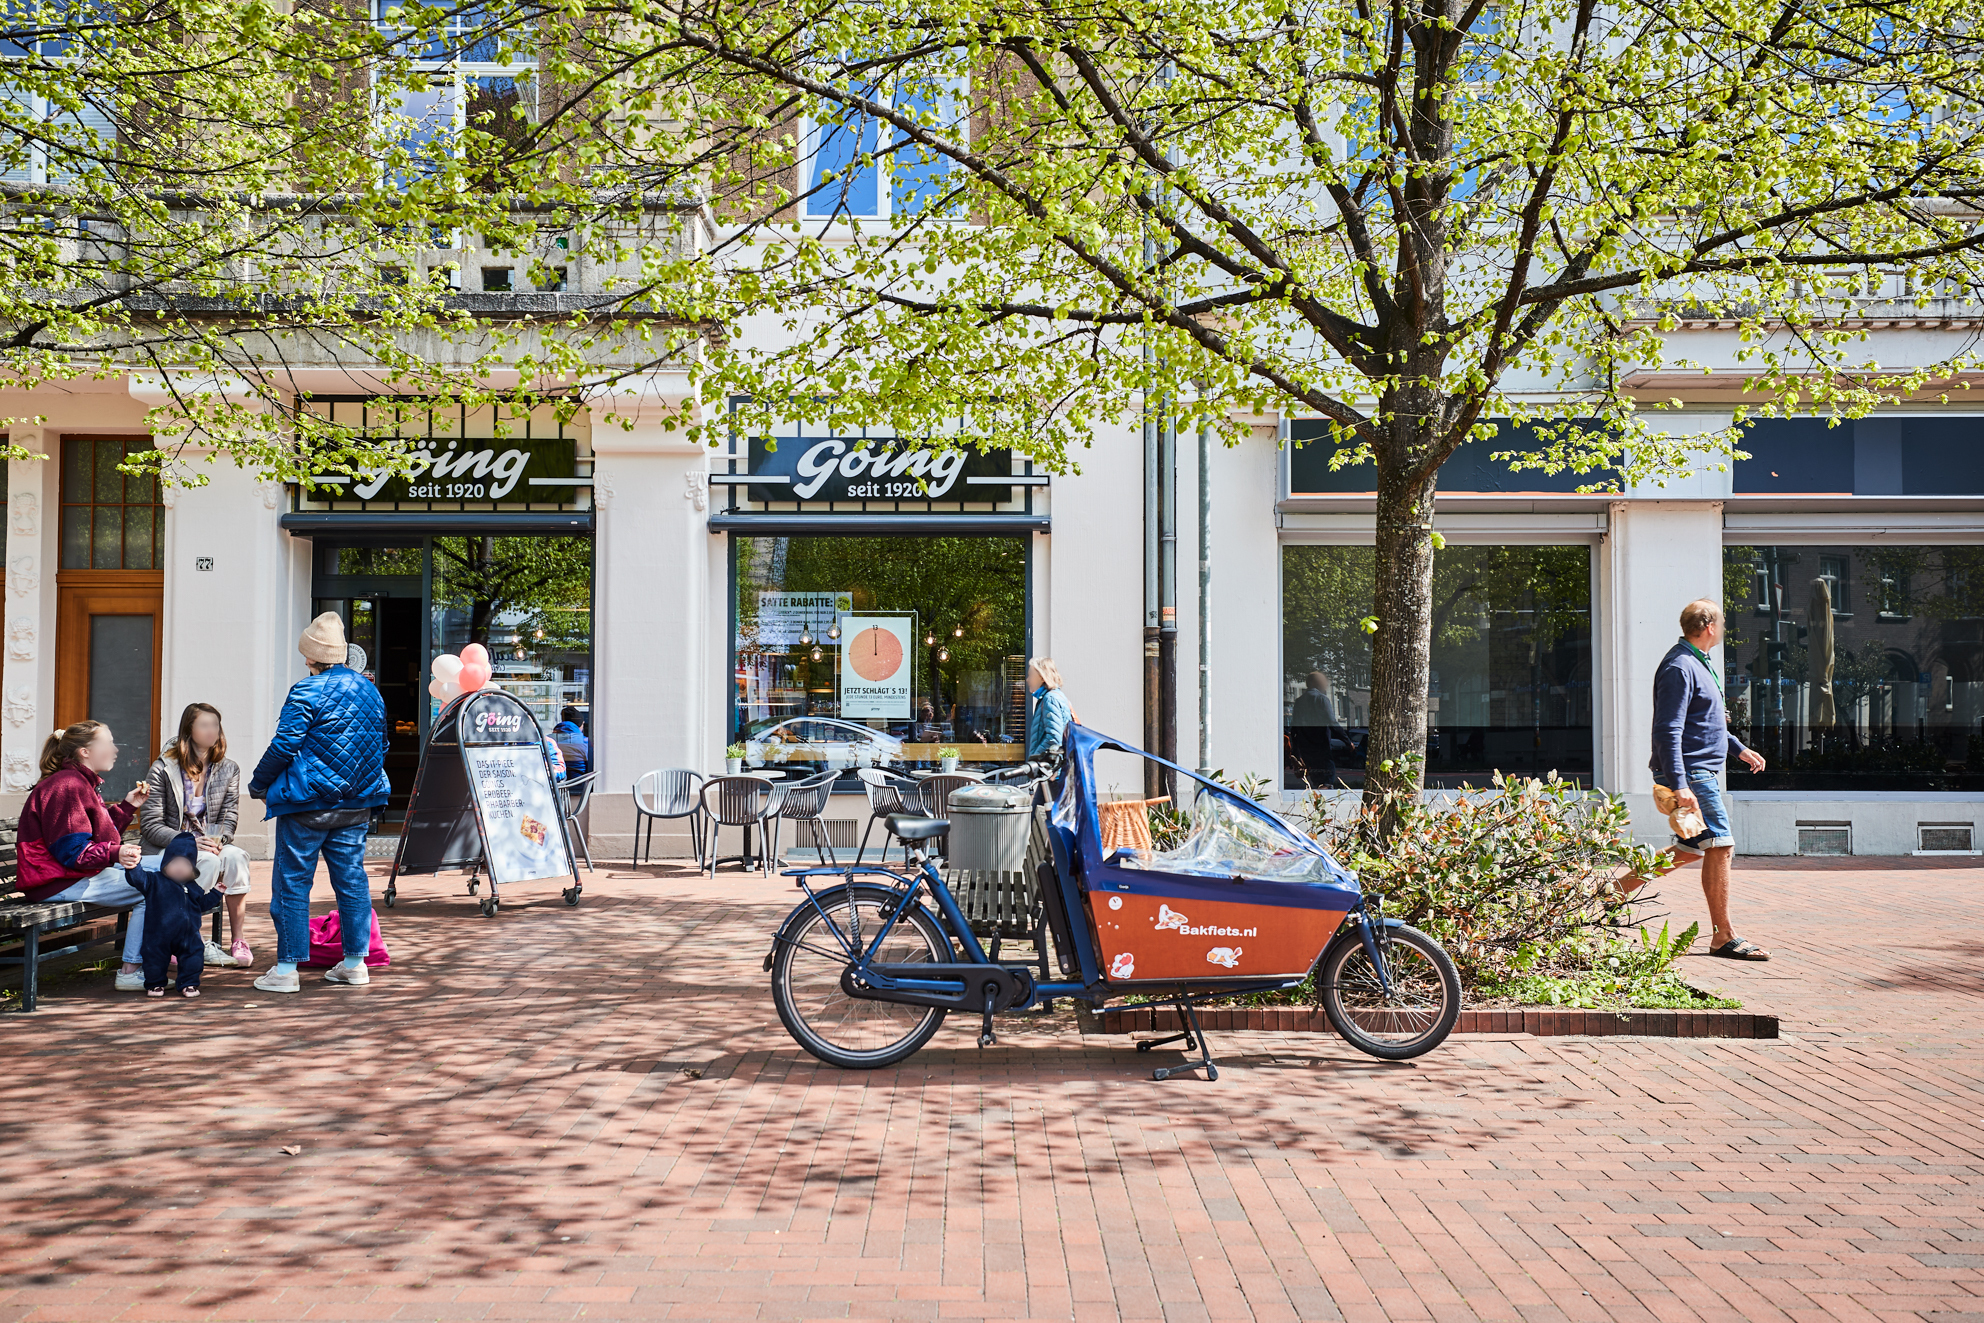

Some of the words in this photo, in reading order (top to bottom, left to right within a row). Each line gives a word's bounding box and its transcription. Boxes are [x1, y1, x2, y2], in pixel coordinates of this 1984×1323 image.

[793, 440, 969, 499] Göing
[408, 483, 441, 498] seit
[446, 483, 485, 498] 1920
[848, 481, 880, 497] seit
[884, 482, 923, 497] 1920
[199, 558, 211, 569] 77
[761, 597, 788, 607] SATTE
[790, 597, 833, 607] RABATTE:
[844, 687, 861, 695] JETZT
[475, 712, 522, 733] Göing
[476, 760, 489, 768] DAS
[490, 759, 515, 768] IT-PIECE
[479, 770, 491, 778] DER
[484, 789, 513, 798] ERDBEER-
[486, 799, 525, 808] RHABARBER-
[1179, 925, 1257, 937] Bakfiets.nl
